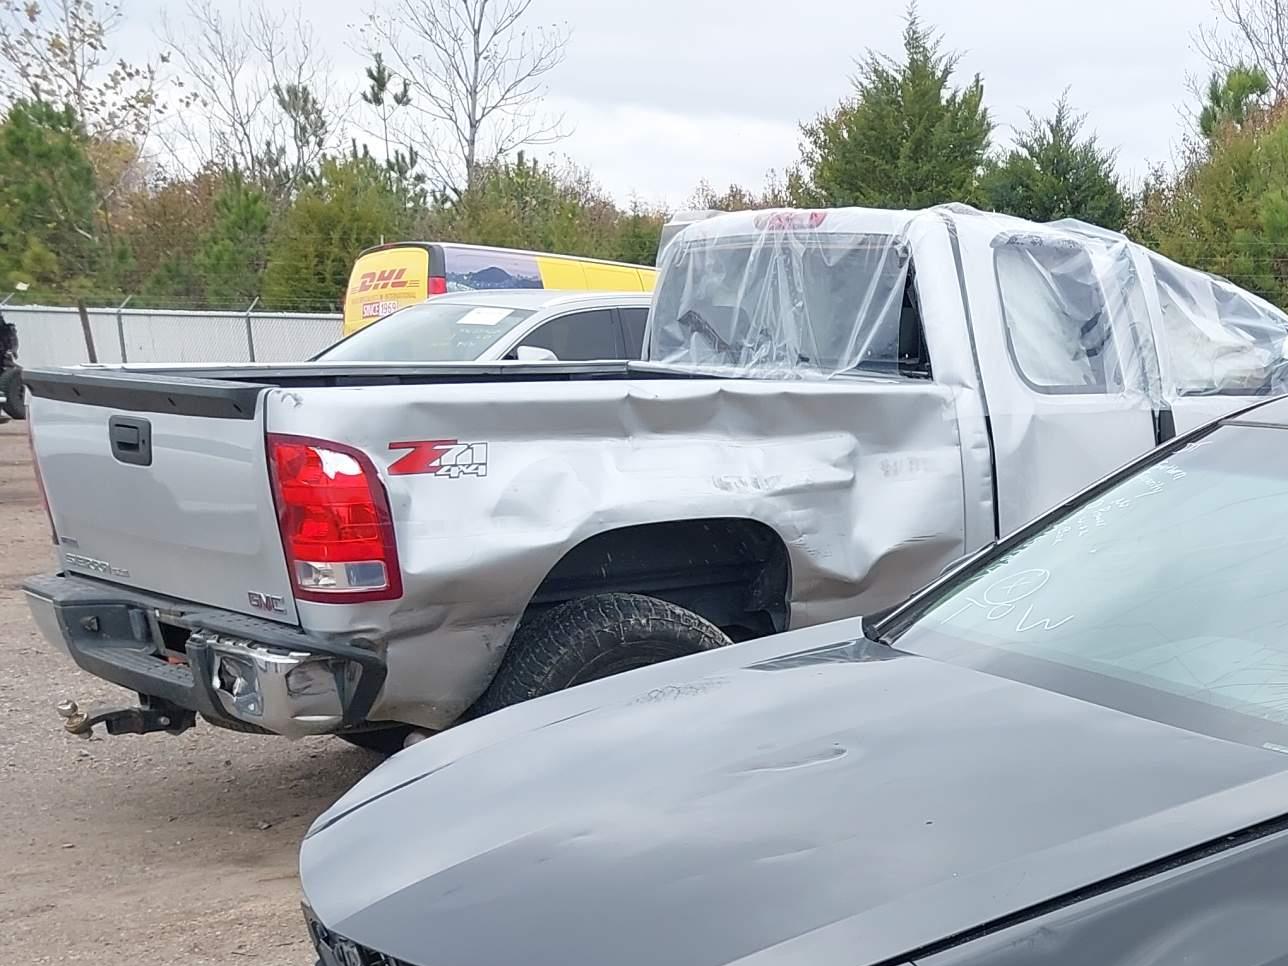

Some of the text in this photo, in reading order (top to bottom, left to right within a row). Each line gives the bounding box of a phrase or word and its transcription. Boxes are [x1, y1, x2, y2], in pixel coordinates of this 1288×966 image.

[360, 268, 408, 292] DHL
[362, 302, 397, 318] SINCE 1969
[387, 439, 488, 476] Z71
[247, 590, 287, 615] GMC
